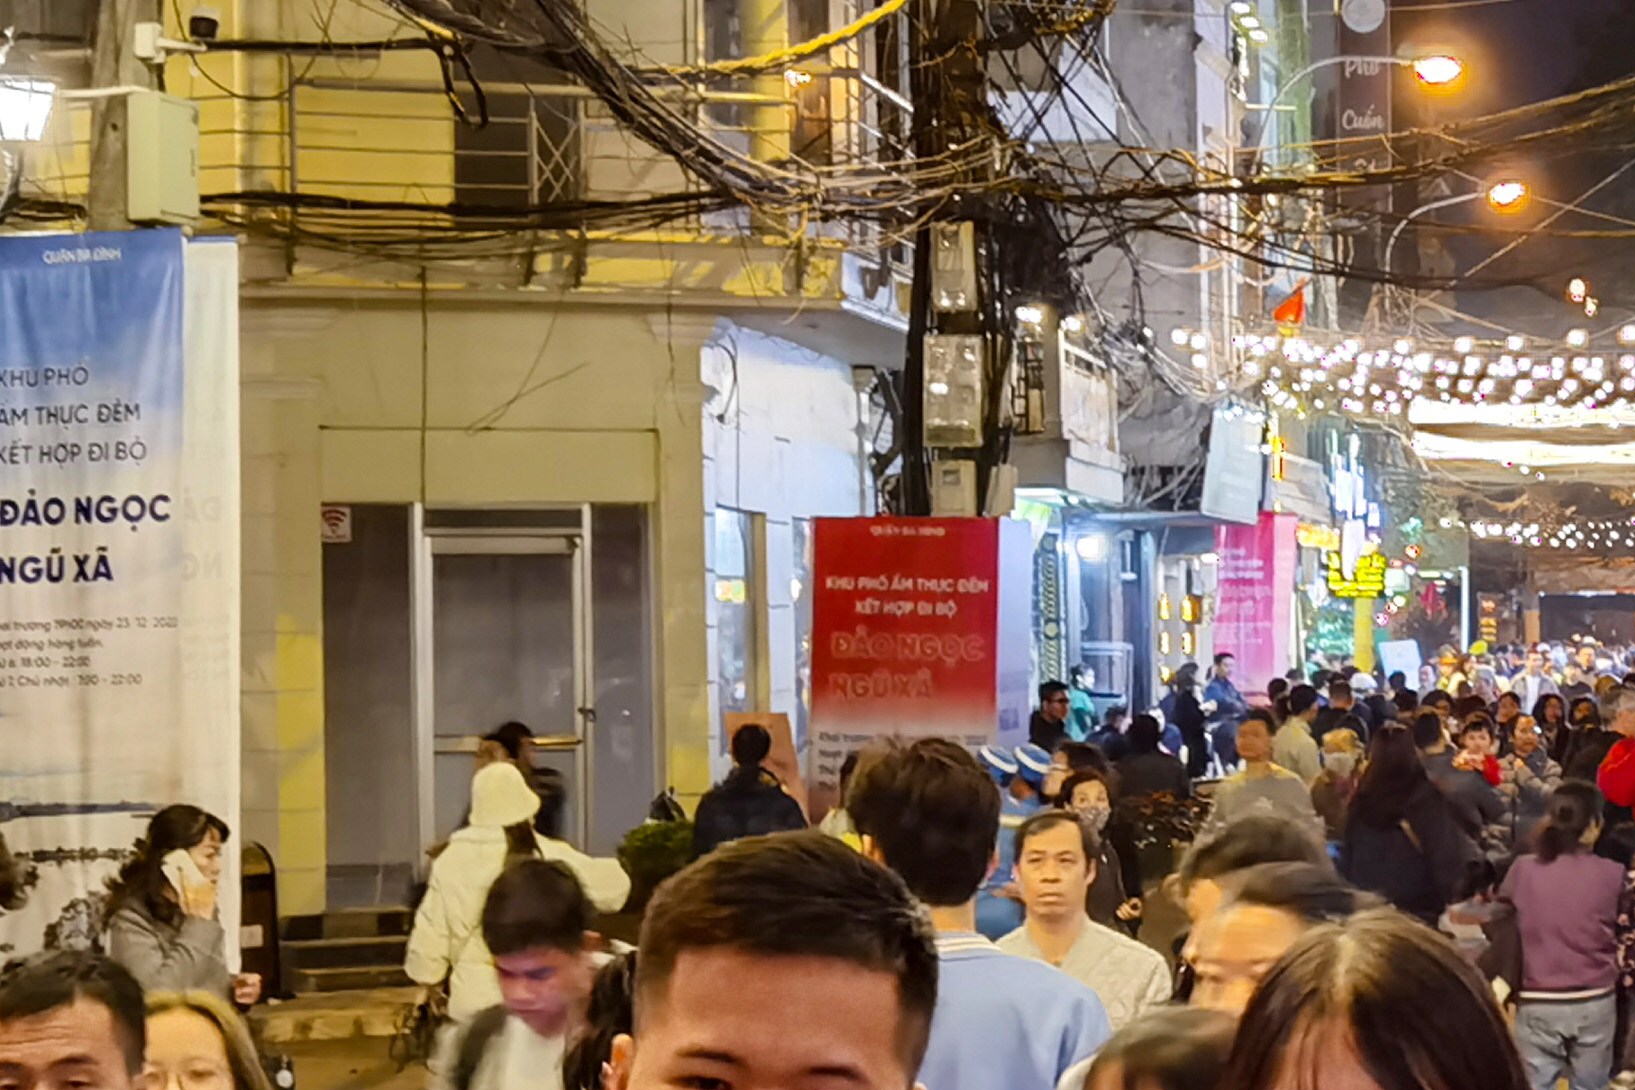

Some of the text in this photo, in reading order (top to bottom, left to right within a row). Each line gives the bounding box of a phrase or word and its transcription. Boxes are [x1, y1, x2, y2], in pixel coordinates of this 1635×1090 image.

[35, 403, 89, 430] THỰC
[39, 441, 82, 468] HỢP
[88, 442, 109, 462] ĐI
[115, 434, 147, 466] BỘ
[0, 488, 171, 532] ĐẢO NGỌC
[0, 546, 114, 584] NGŨ XÃ
